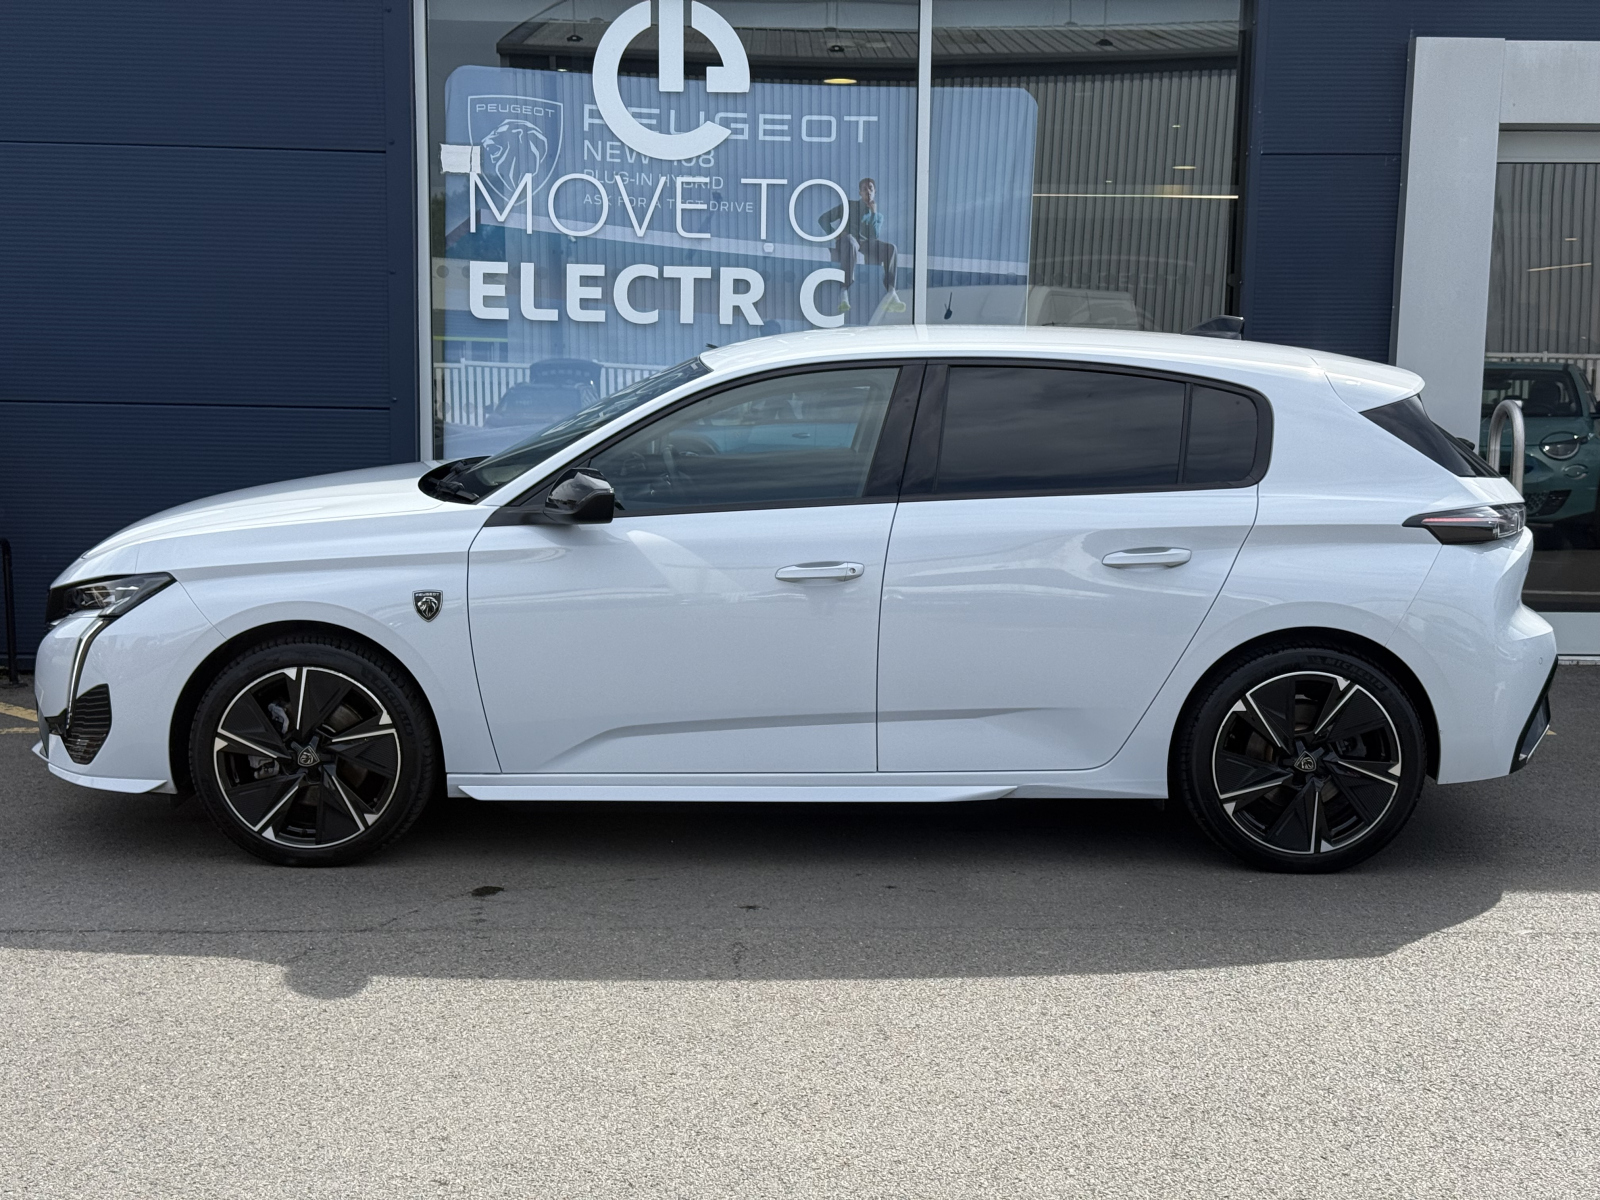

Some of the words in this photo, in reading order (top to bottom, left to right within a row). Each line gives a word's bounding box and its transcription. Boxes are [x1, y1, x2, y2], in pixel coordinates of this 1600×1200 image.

[476, 103, 555, 118] PEUGEOT
[584, 169, 653, 187] PLUG-IN
[470, 172, 711, 238] MOVE
[741, 178, 849, 242] TO
[710, 201, 754, 213] DRIVE
